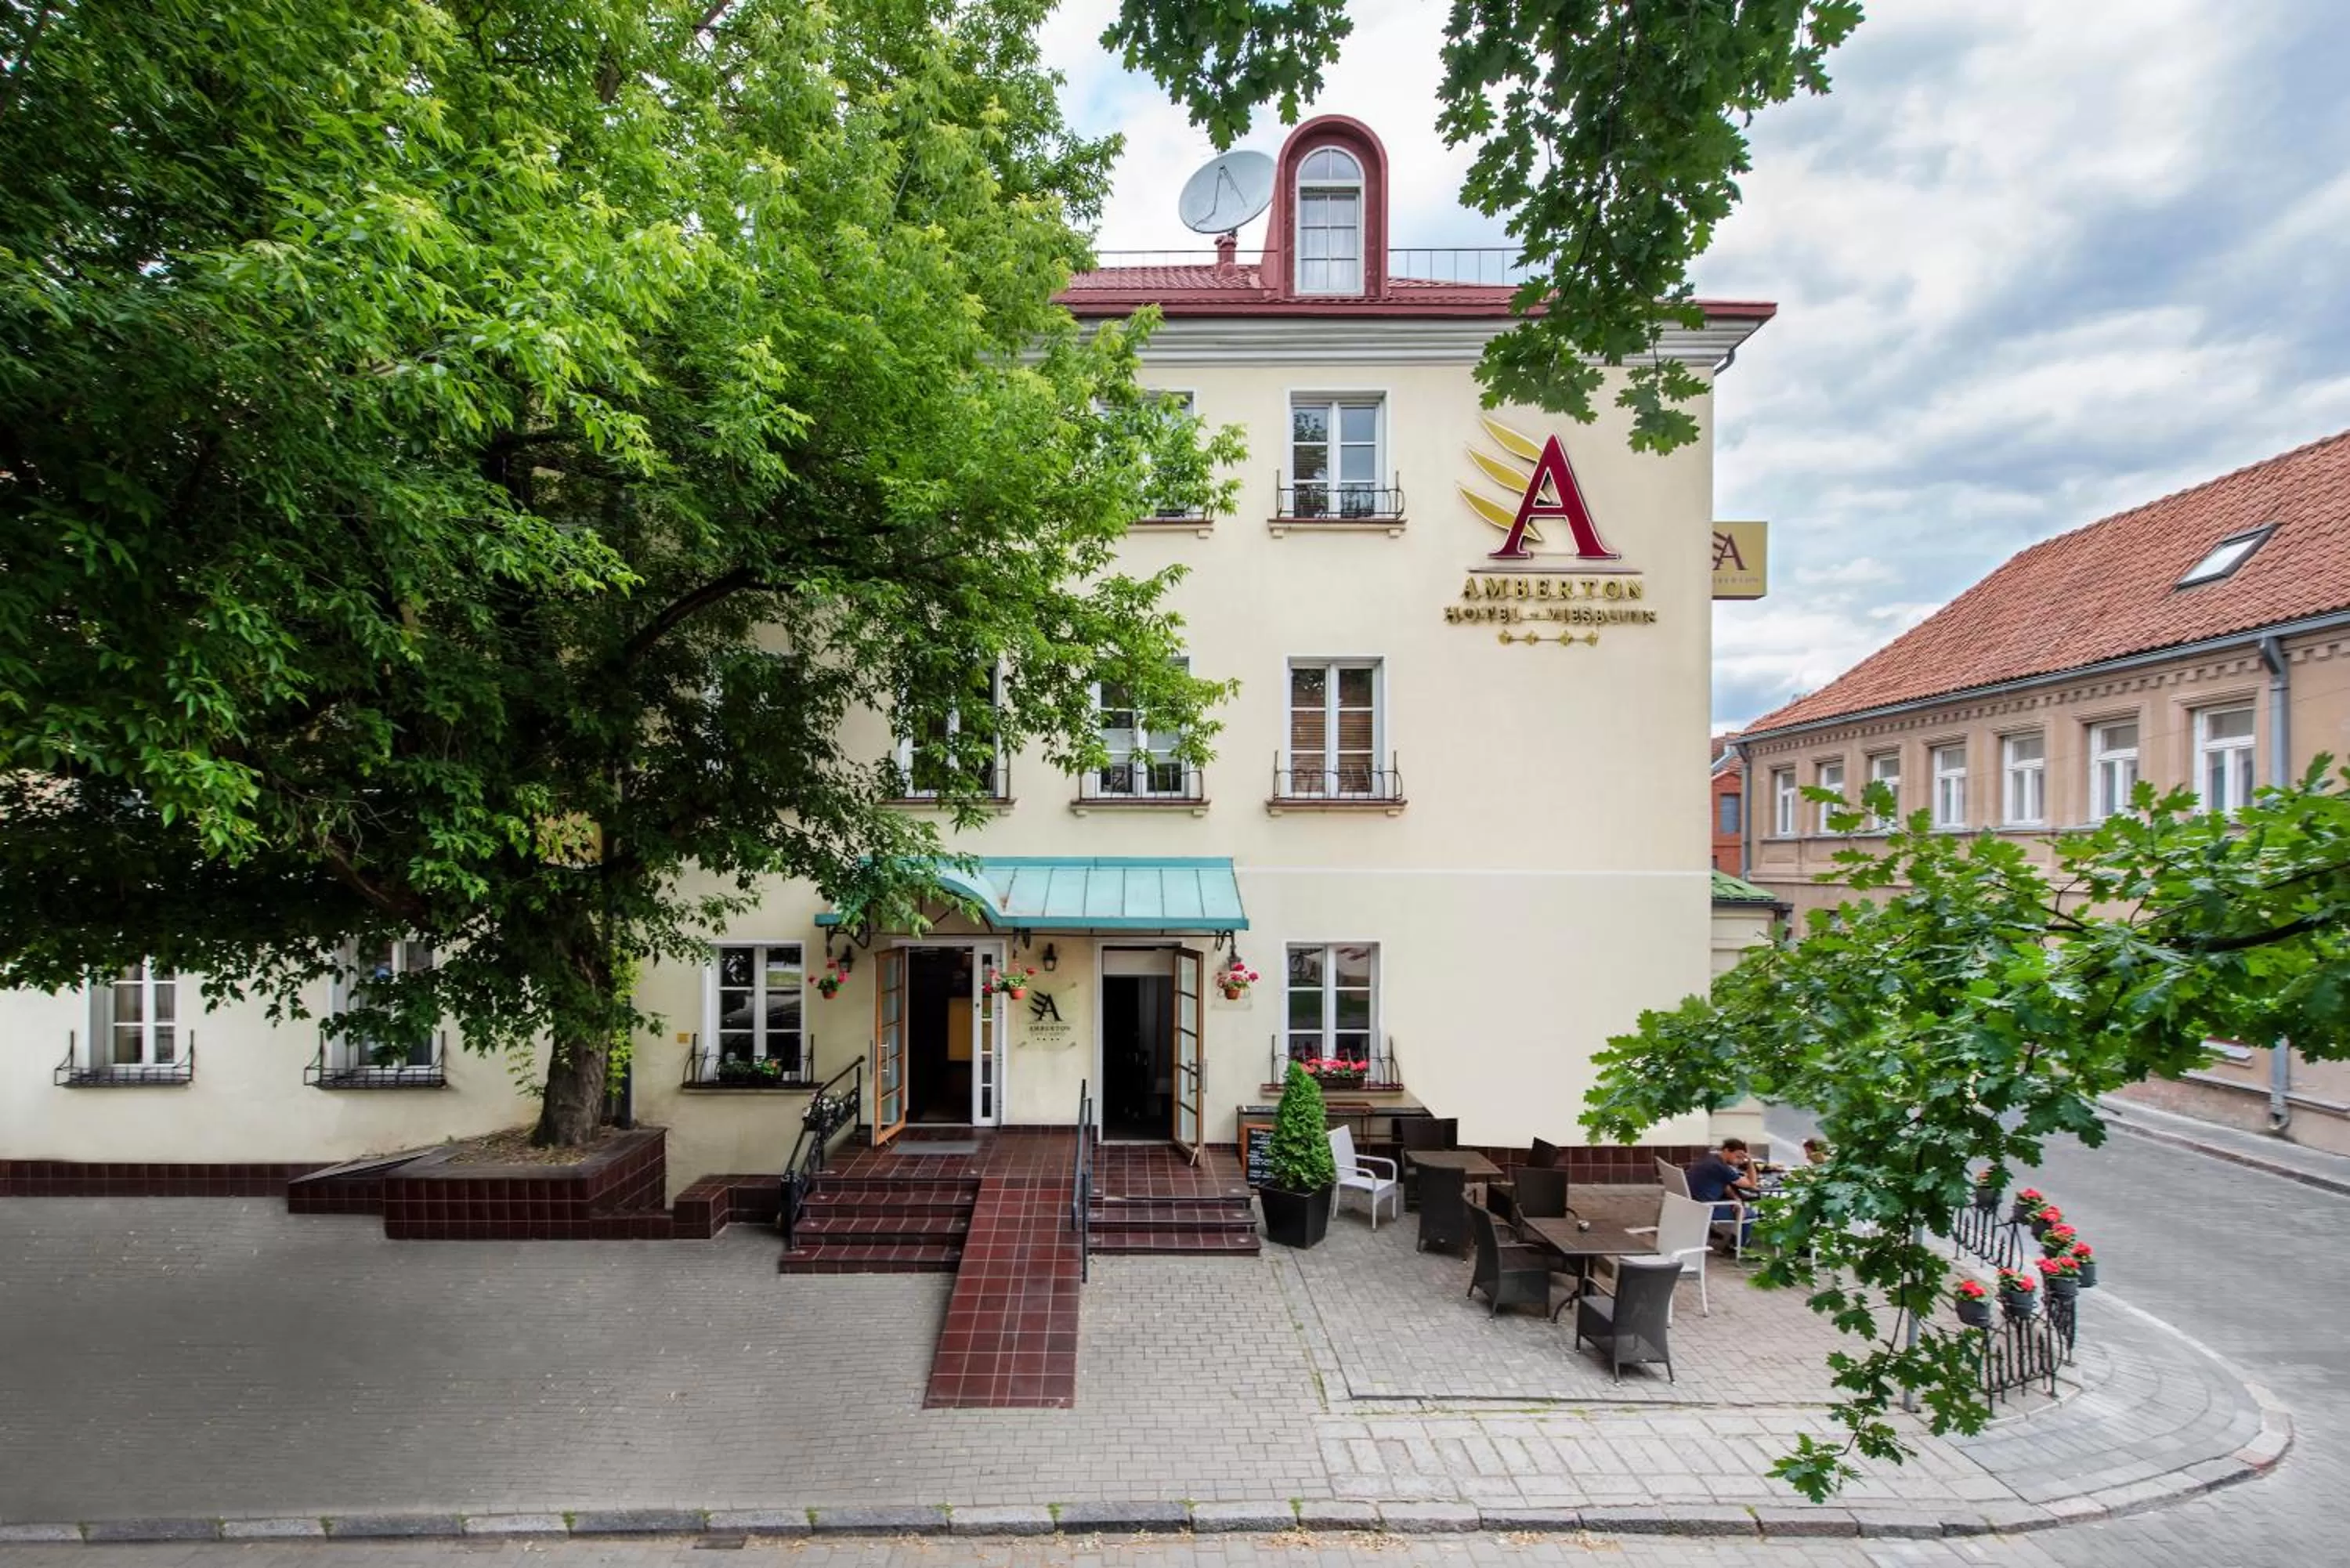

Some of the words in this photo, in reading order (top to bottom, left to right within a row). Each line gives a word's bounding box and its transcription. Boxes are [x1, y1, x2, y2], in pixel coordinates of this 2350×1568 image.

[1488, 432, 1622, 560] A
[1463, 576, 1643, 601] AMBERTON
[1444, 605, 1522, 625] HOTEL
